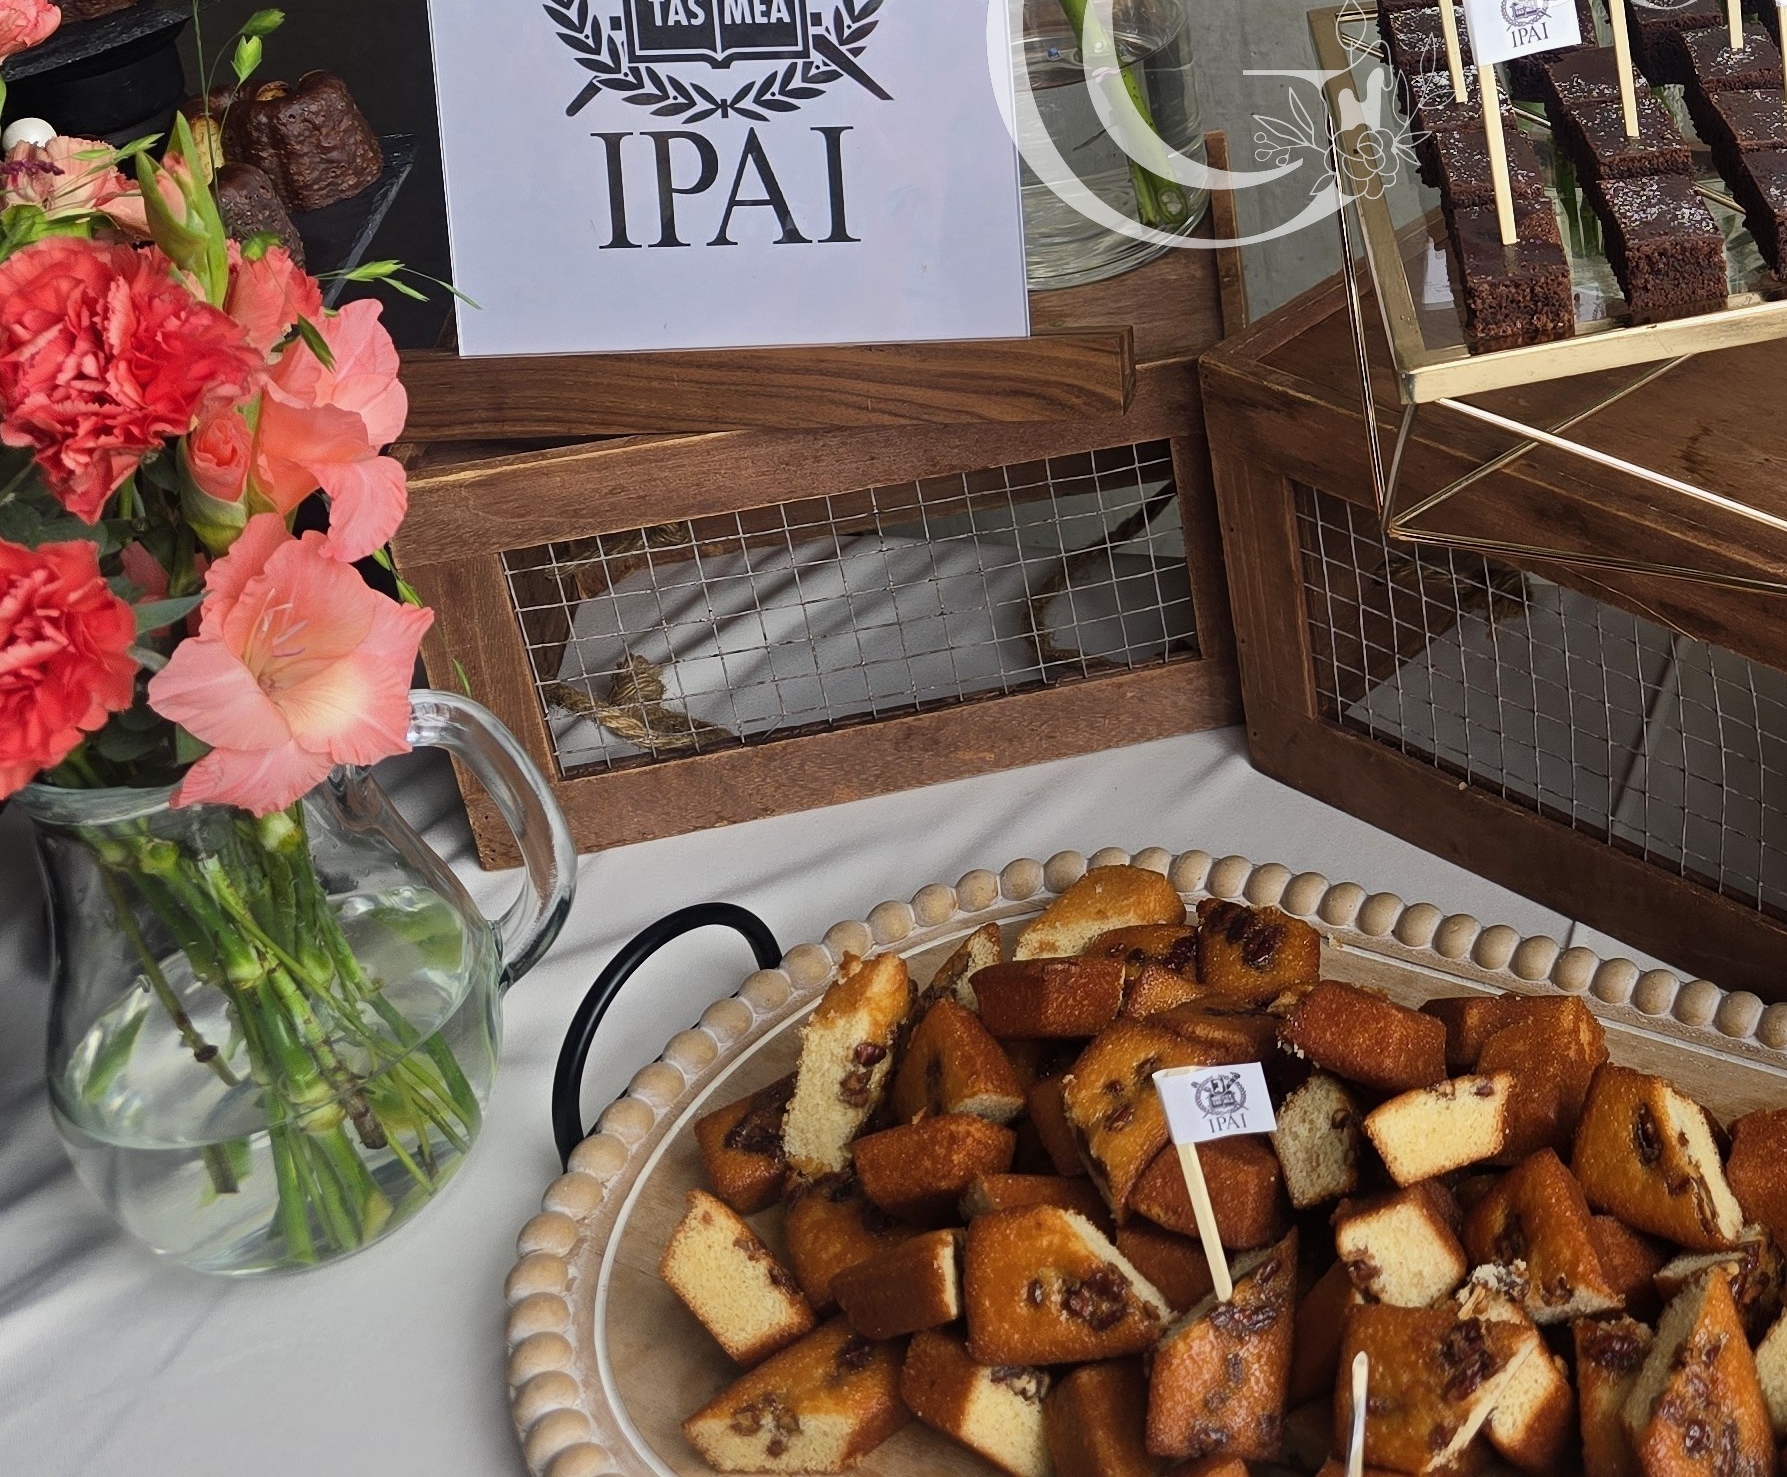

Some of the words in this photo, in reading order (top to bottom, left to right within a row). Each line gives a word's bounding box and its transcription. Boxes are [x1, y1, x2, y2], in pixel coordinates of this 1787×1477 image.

[1512, 22, 1548, 46] IPAI
[591, 125, 861, 250] IPAI
[1209, 1113, 1246, 1133] IPAI
